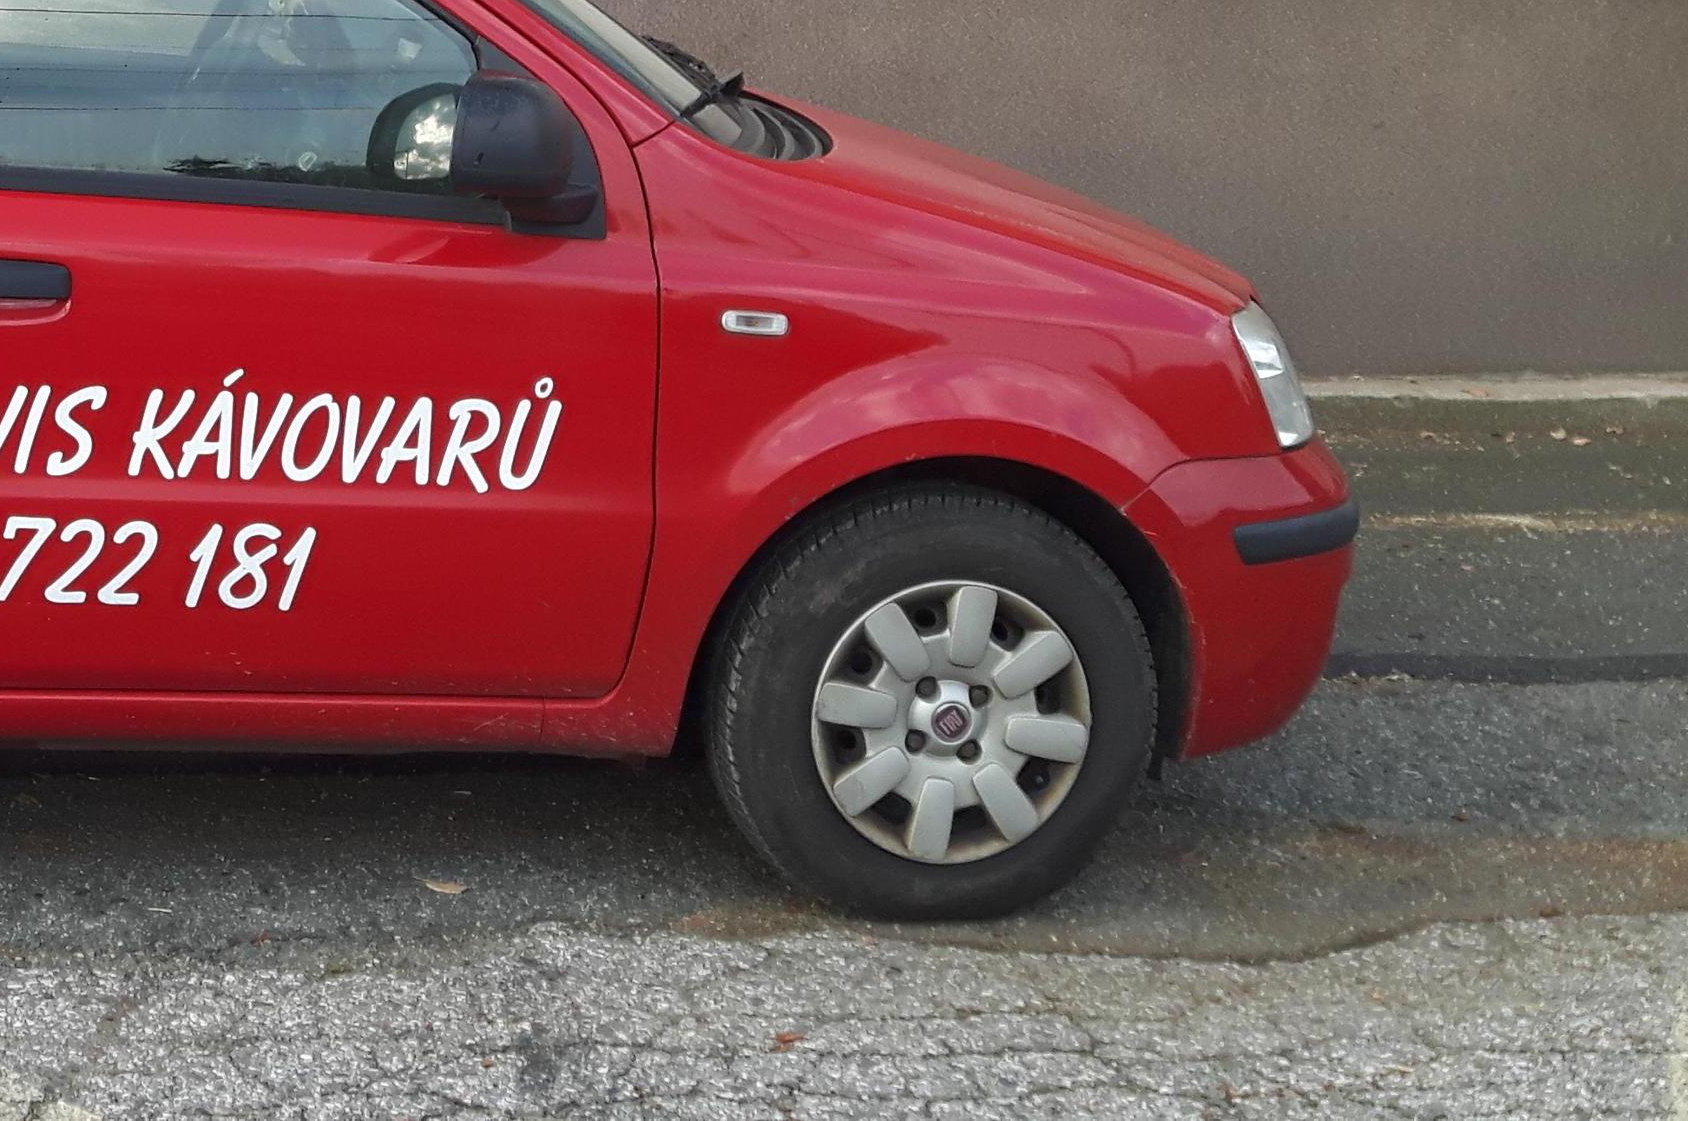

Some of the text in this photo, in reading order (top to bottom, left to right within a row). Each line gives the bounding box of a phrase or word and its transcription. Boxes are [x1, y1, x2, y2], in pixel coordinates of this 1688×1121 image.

[127, 368, 563, 494] KÁVOVARŮ
[184, 522, 317, 612] 181
[939, 709, 964, 735] FIAT
